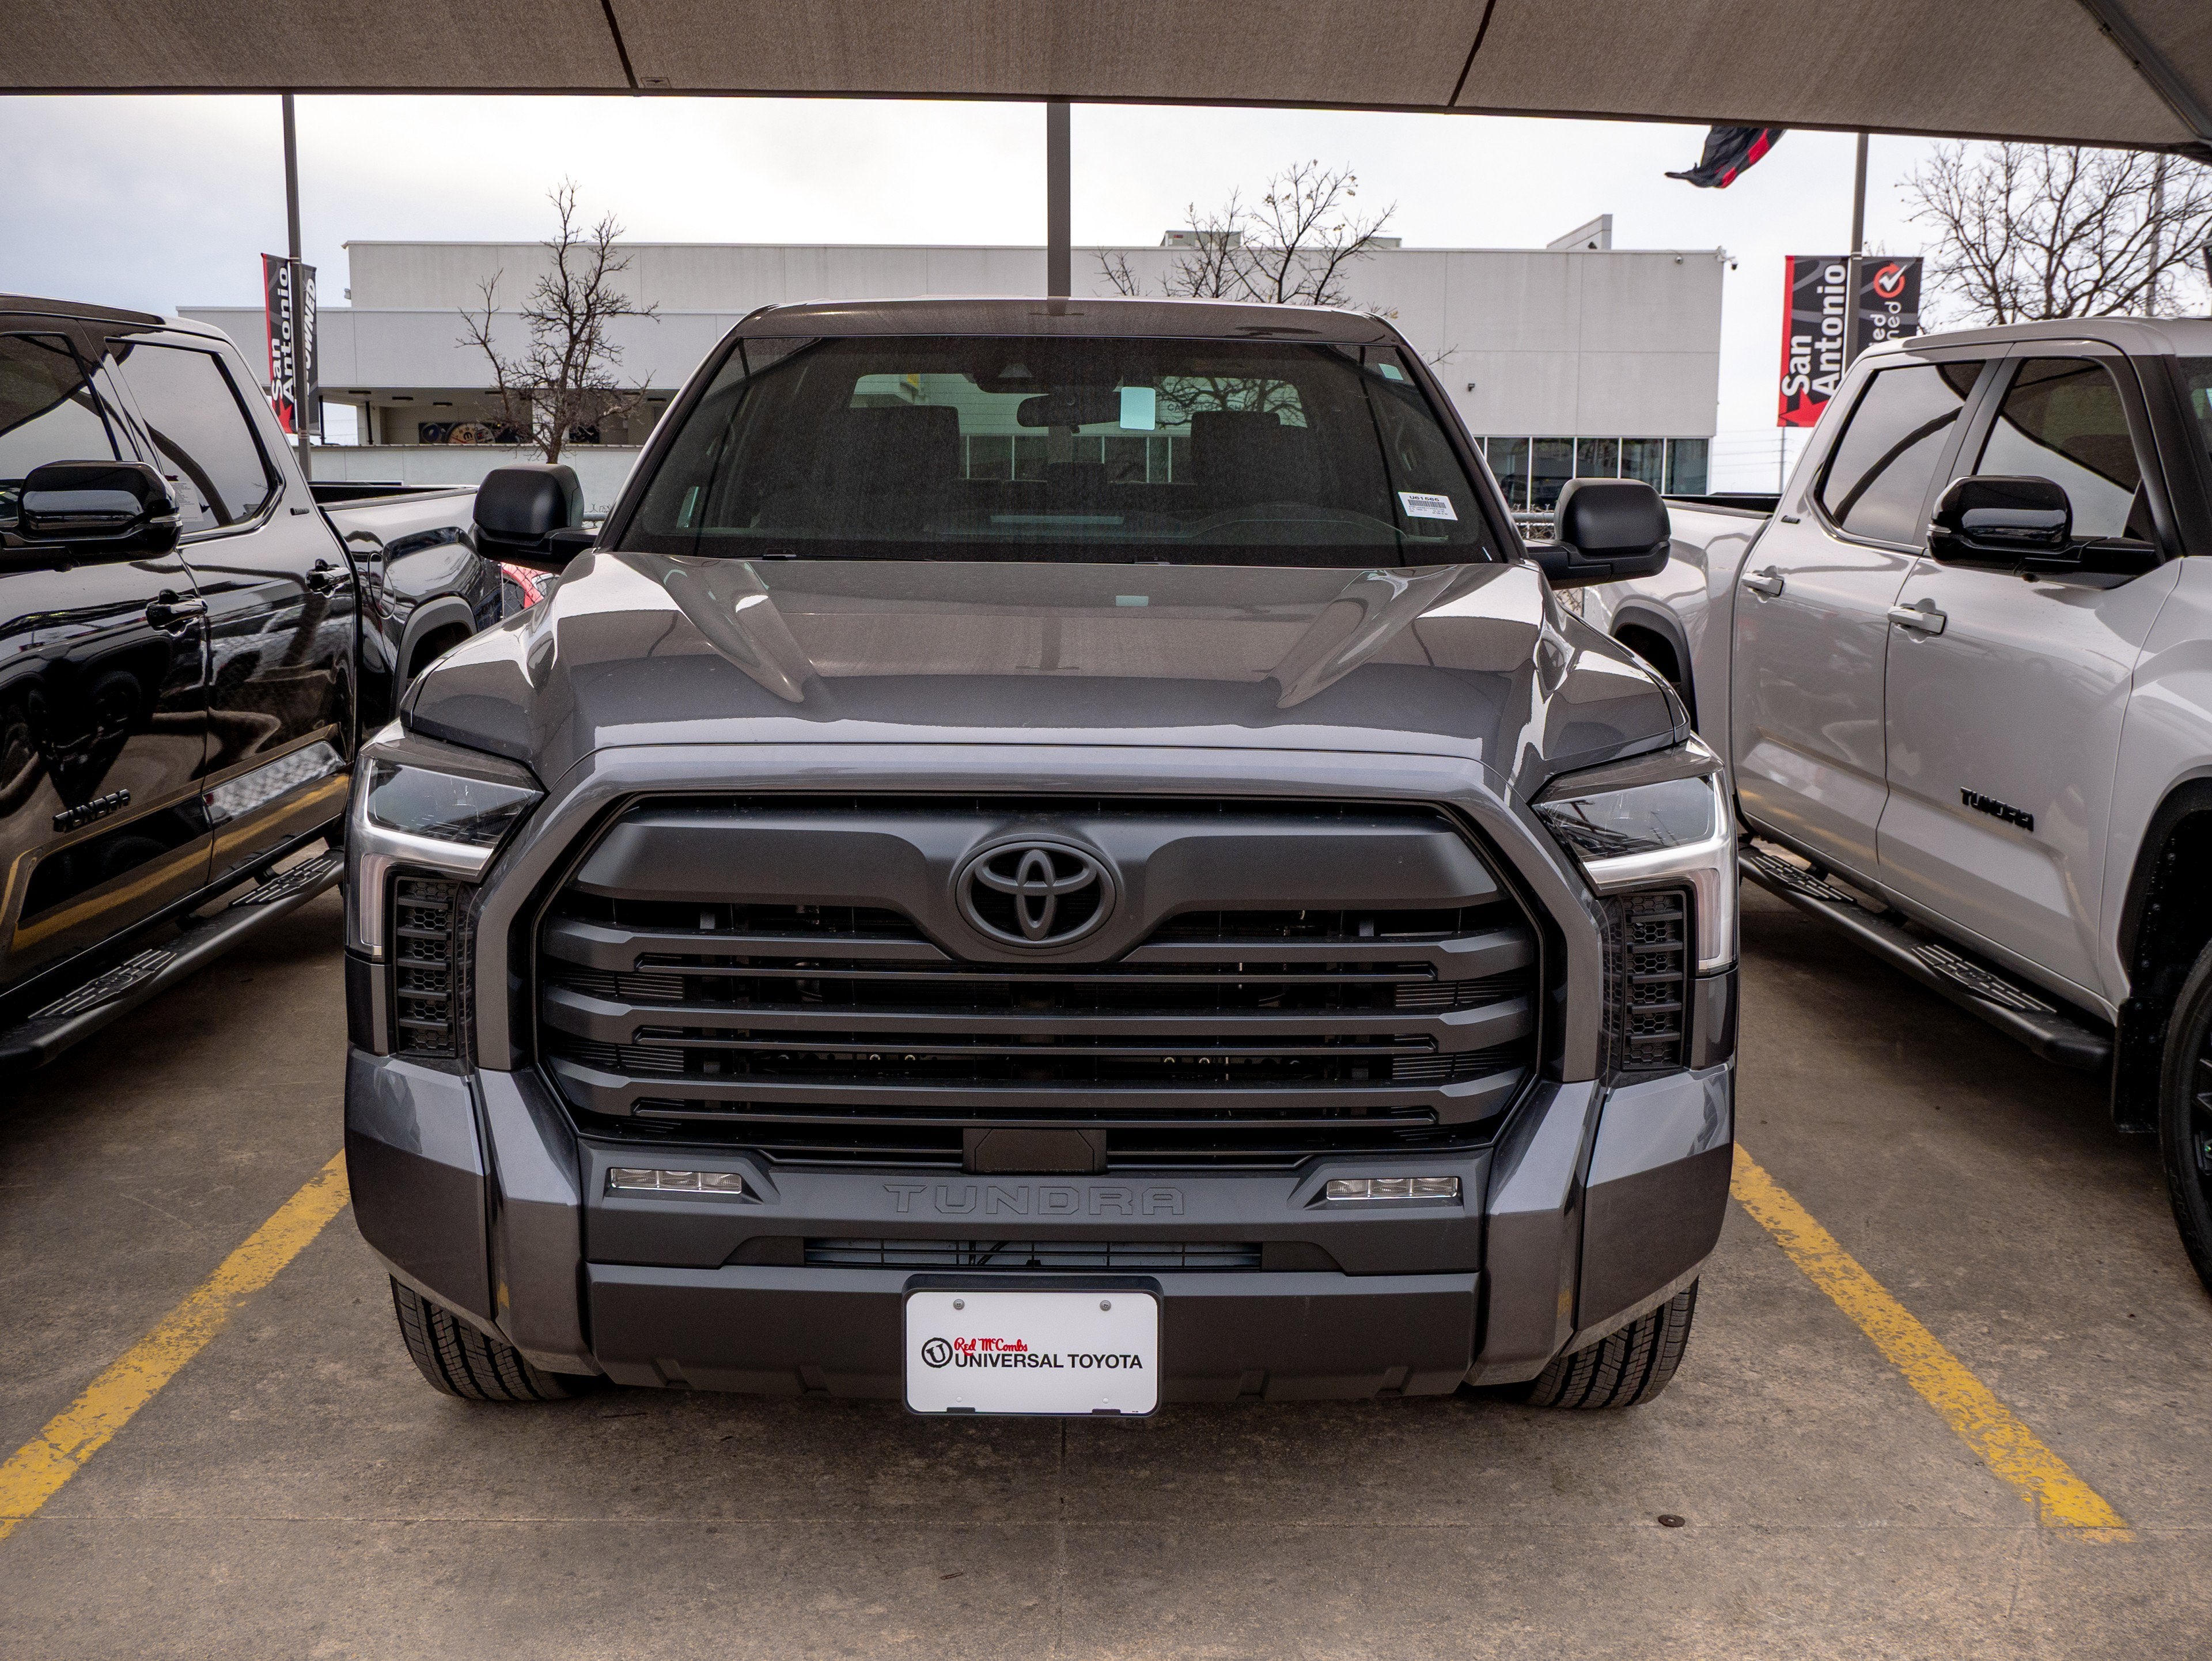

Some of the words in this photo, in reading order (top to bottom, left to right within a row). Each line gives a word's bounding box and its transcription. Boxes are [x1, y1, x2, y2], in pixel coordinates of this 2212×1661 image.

[278, 267, 295, 404] Antonio
[1812, 264, 1847, 396] Antonio
[271, 338, 283, 401] San
[1781, 335, 1812, 397] San
[1960, 786, 2035, 832] TUNDRA
[883, 1184, 1185, 1216] TUNDRA
[954, 1337, 976, 1356] Red
[978, 1338, 1028, 1352] McCombs
[955, 1353, 1064, 1368] UNIVERSAL
[1067, 1354, 1143, 1369] TOYOTA
